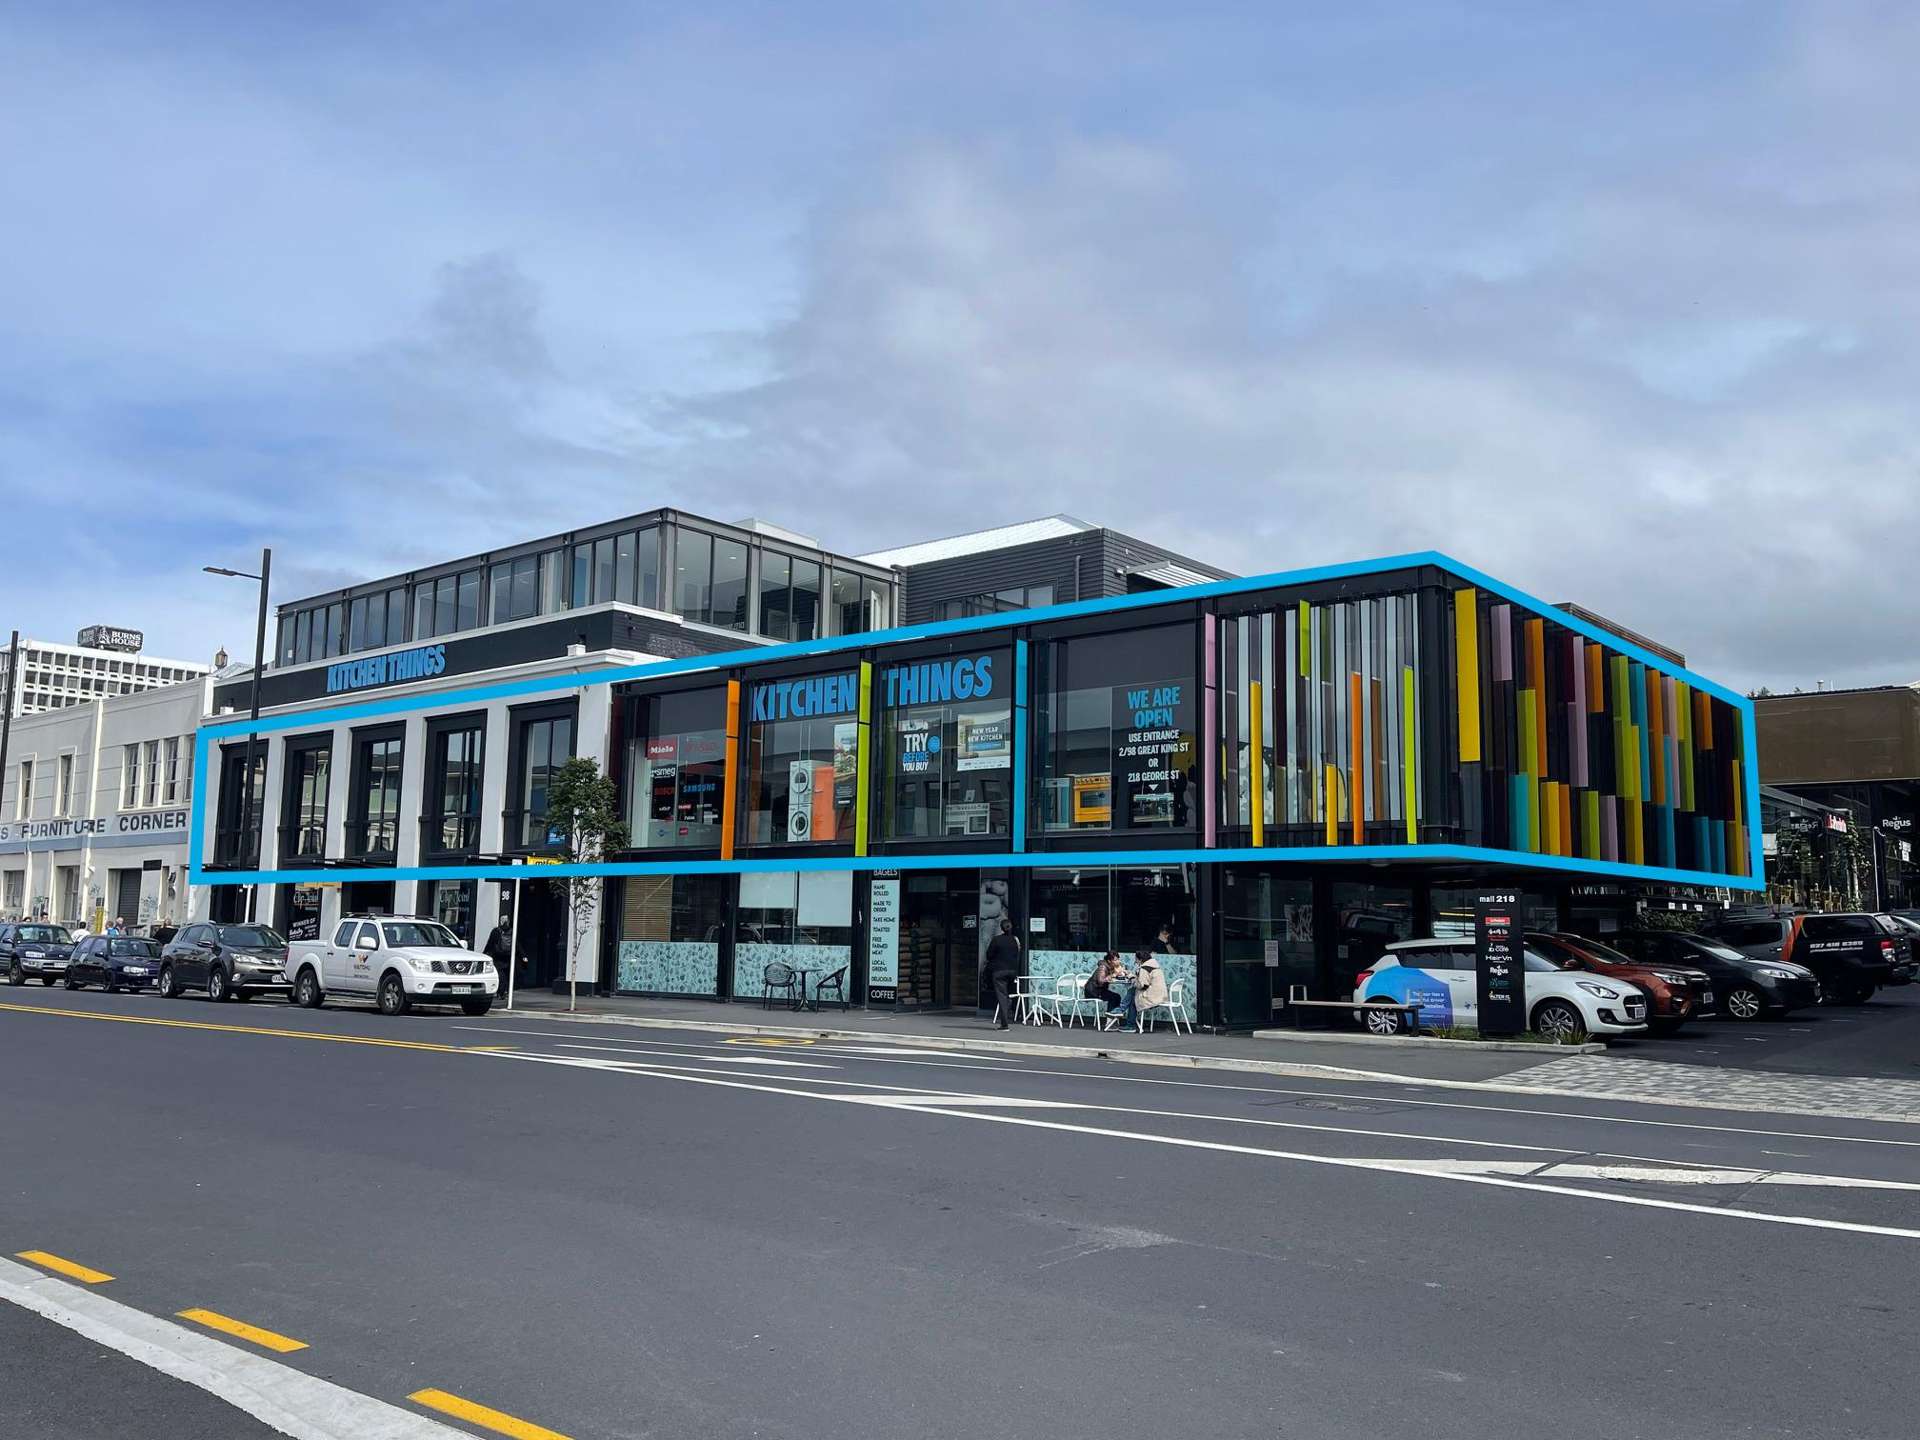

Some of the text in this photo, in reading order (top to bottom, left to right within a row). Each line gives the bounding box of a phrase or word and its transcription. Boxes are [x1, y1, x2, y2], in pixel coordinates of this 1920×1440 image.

[111, 630, 142, 641] BURNS
[111, 637, 141, 648] HOUSE
[326, 644, 446, 693] KITCHEN THINGS
[752, 656, 993, 722] KITCHEN THINGS
[1128, 686, 1180, 709] WE ARE
[1134, 708, 1173, 728] OPEN
[904, 733, 928, 752] TRY
[1128, 729, 1180, 743] USE ENTRANCE
[1119, 742, 1189, 756] 2/98 GREAT KING ST
[903, 752, 929, 762] BEFORE
[1148, 758, 1158, 767] OR
[656, 767, 676, 776] smeg
[903, 761, 929, 772] YOU BUY
[1128, 770, 1180, 782] 218 GEORGE ST
[21, 818, 106, 839] FURNITURE
[119, 812, 187, 832] CORNER
[1882, 816, 1912, 830] Regus
[1480, 895, 1515, 903] mall 218
[871, 989, 896, 999] COFFEE
